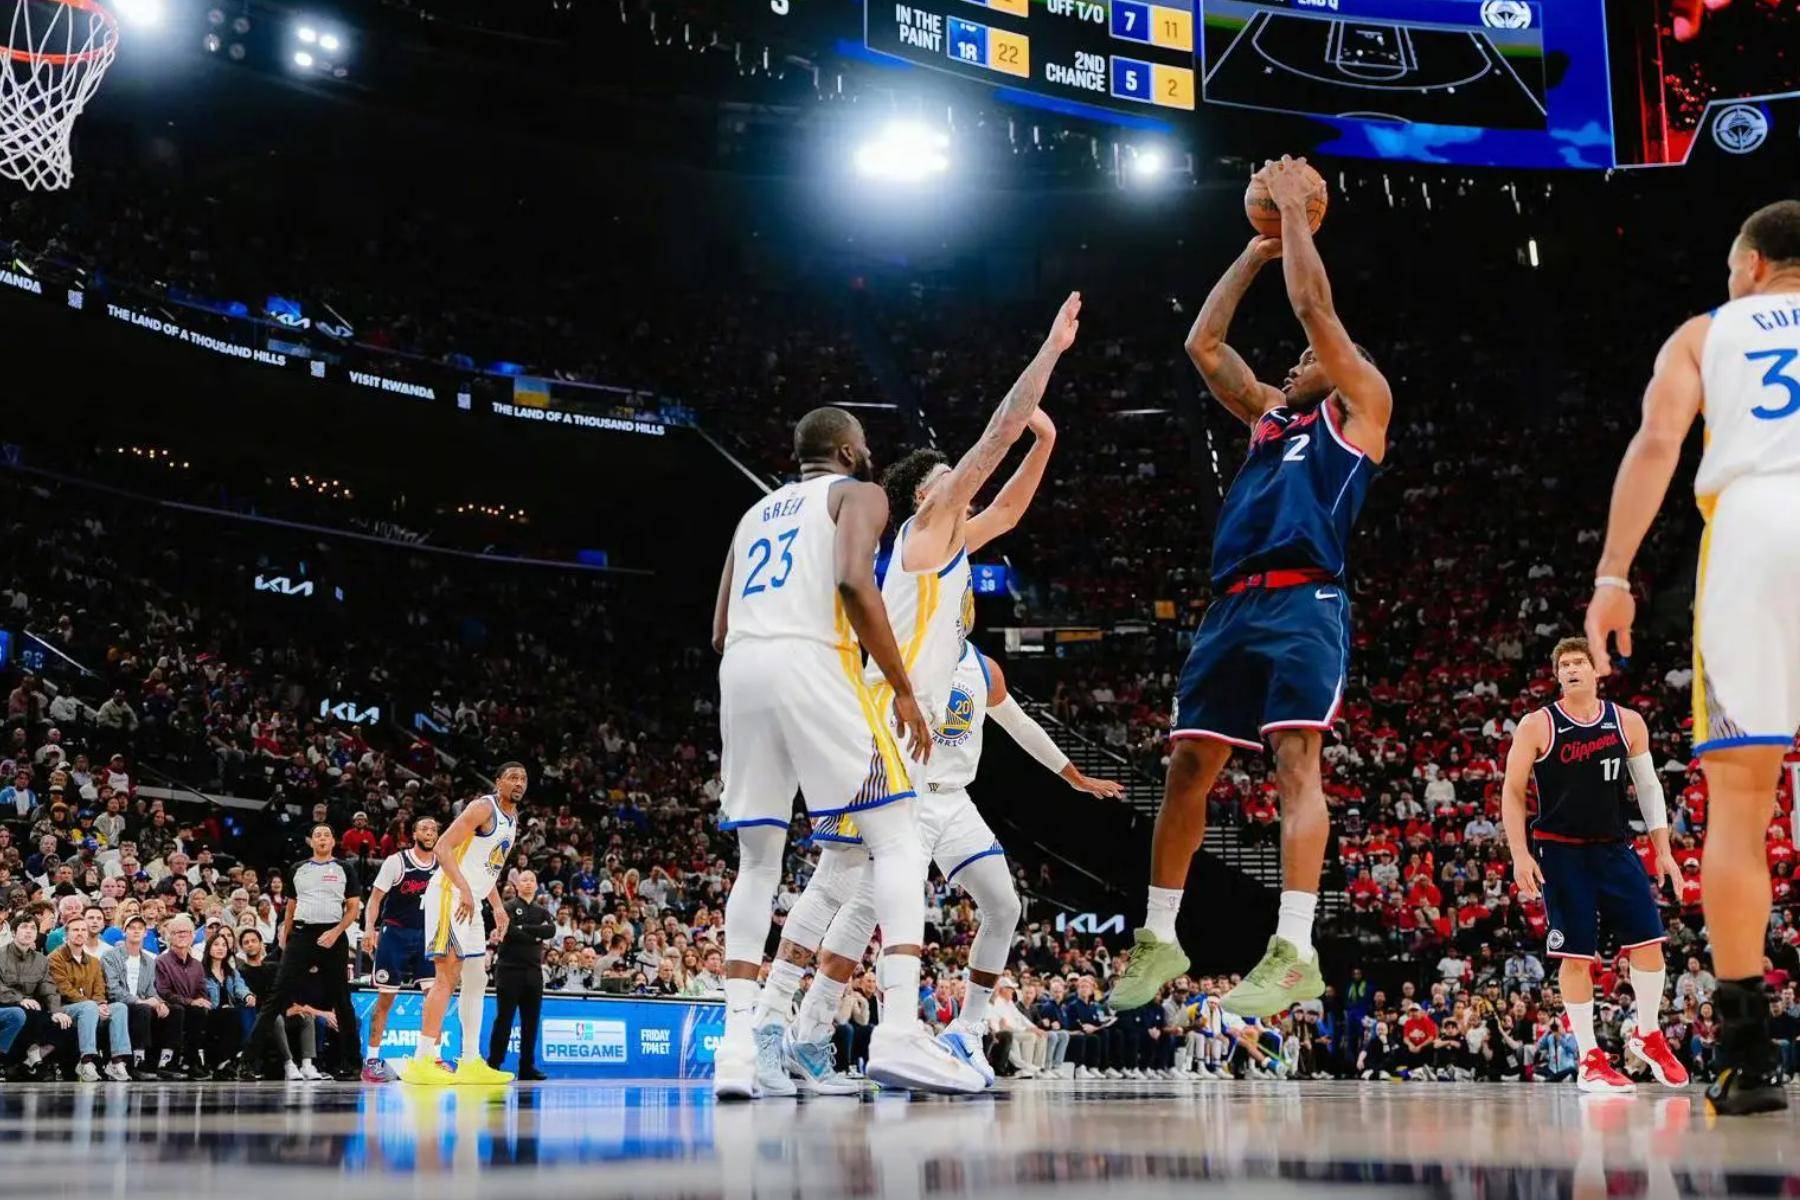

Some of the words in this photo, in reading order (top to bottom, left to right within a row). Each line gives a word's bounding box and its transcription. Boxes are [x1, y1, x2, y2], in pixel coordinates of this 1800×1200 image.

[896, 3, 912, 27] IN
[912, 8, 942, 34] THE
[1124, 11, 1136, 32] 7
[1164, 20, 1179, 39] 11
[899, 24, 942, 52] PAINT
[998, 42, 1019, 64] 22
[1074, 51, 1106, 74] 2ND
[1045, 63, 1106, 93] CHANCE
[1125, 70, 1138, 91] 5
[1168, 78, 1178, 98] 2
[107, 303, 131, 323] THE
[131, 311, 163, 332] LAND
[163, 322, 181, 338] OF
[180, 328, 190, 342] A
[190, 330, 252, 360] THOUSAND
[253, 349, 287, 367] HILLS
[348, 370, 381, 388] VISIT
[382, 378, 436, 400] RWANDA
[1744, 348, 1800, 421] 3
[492, 402, 514, 417] THE
[514, 406, 545, 422] LAND
[546, 410, 563, 423] OF
[563, 414, 573, 425] A
[573, 414, 635, 433] THOUSAND
[635, 423, 666, 437] HILLS
[1282, 433, 1311, 462] 2
[742, 527, 800, 600] 23
[254, 574, 314, 597] KIA
[320, 698, 380, 726] KIA
[1560, 732, 1619, 765] Clippers
[1055, 912, 1125, 935] KIA
[640, 1028, 671, 1042] FRIDAY
[545, 1043, 625, 1058] PREGAME
